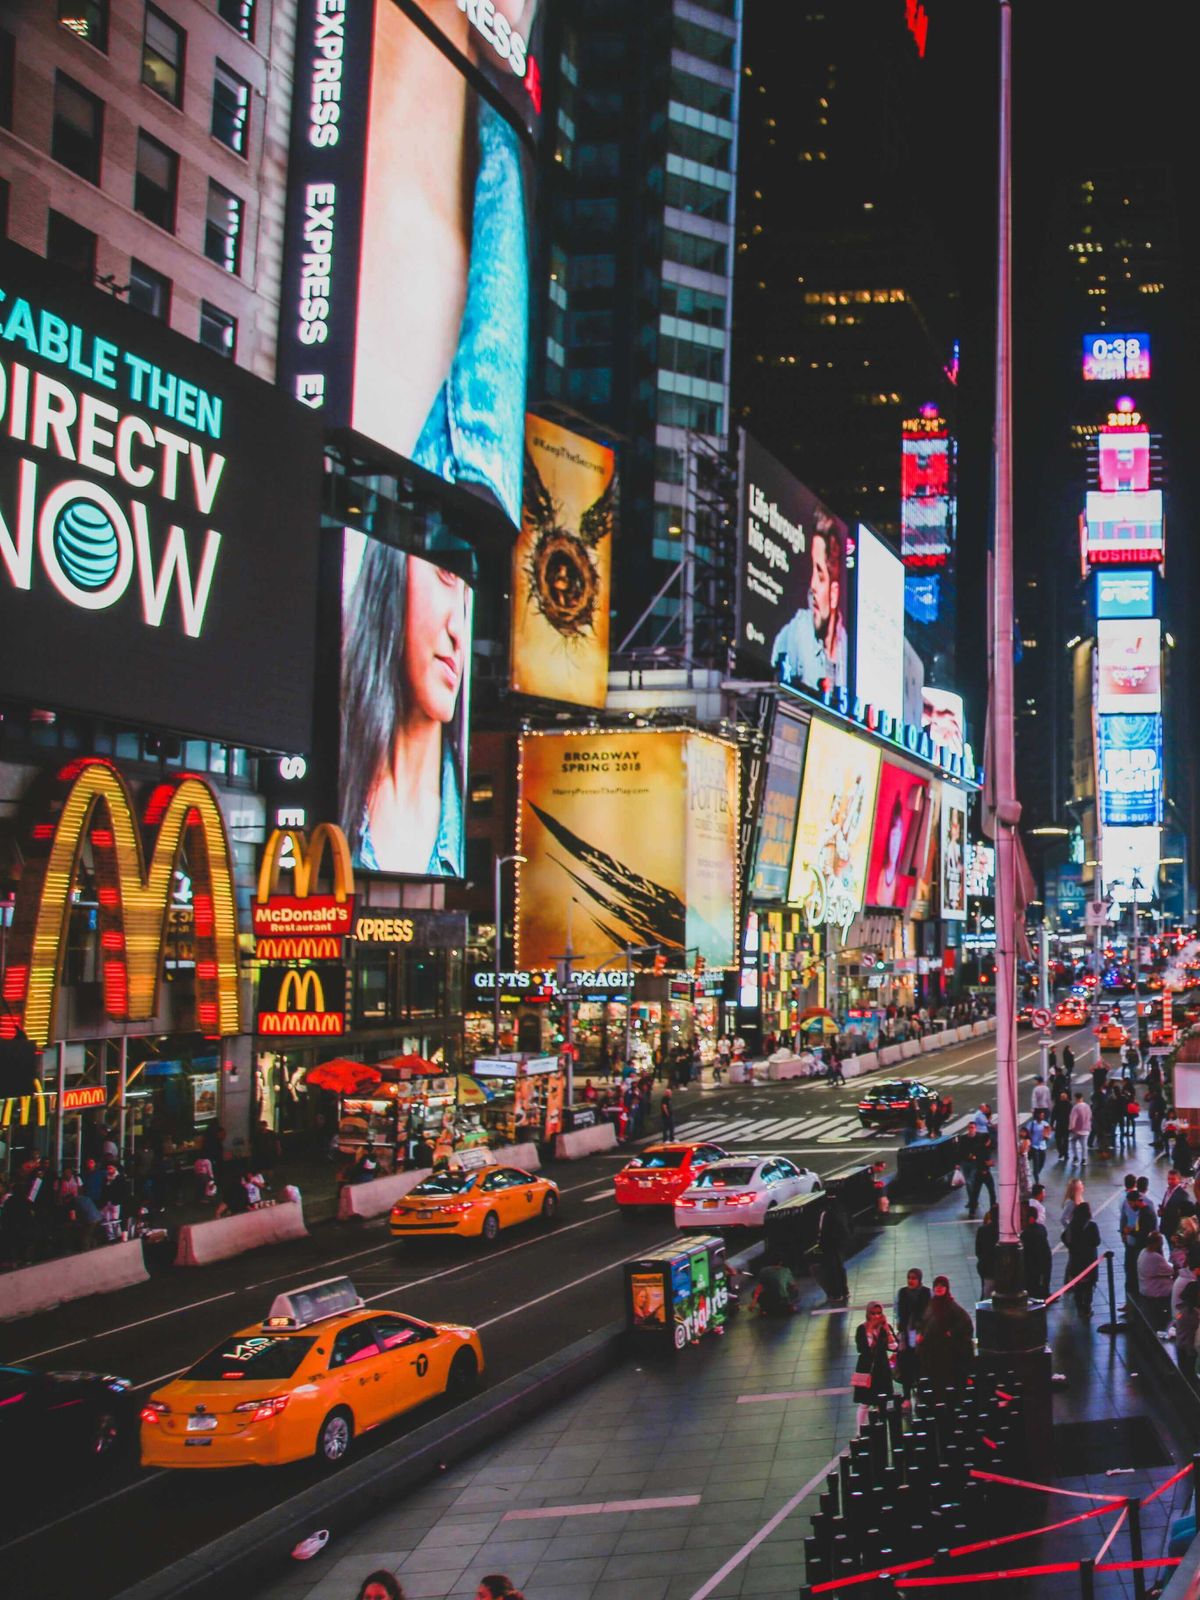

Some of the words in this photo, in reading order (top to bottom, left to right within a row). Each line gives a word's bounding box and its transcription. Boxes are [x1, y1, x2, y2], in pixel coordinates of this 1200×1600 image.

[309, 0, 346, 148] EXPRESS
[298, 183, 336, 345] EXPRESS
[0, 288, 119, 390] ABLE
[123, 351, 223, 439] THEN
[0, 360, 226, 515] IRECTV
[0, 457, 222, 638] NOW
[1088, 549, 1161, 563] TOSHIBA
[562, 763, 610, 773] SPRING
[615, 763, 641, 772] 2018
[564, 752, 640, 761] BROADWAY
[256, 907, 348, 922] McDonald's
[270, 923, 332, 932] Restaurant
